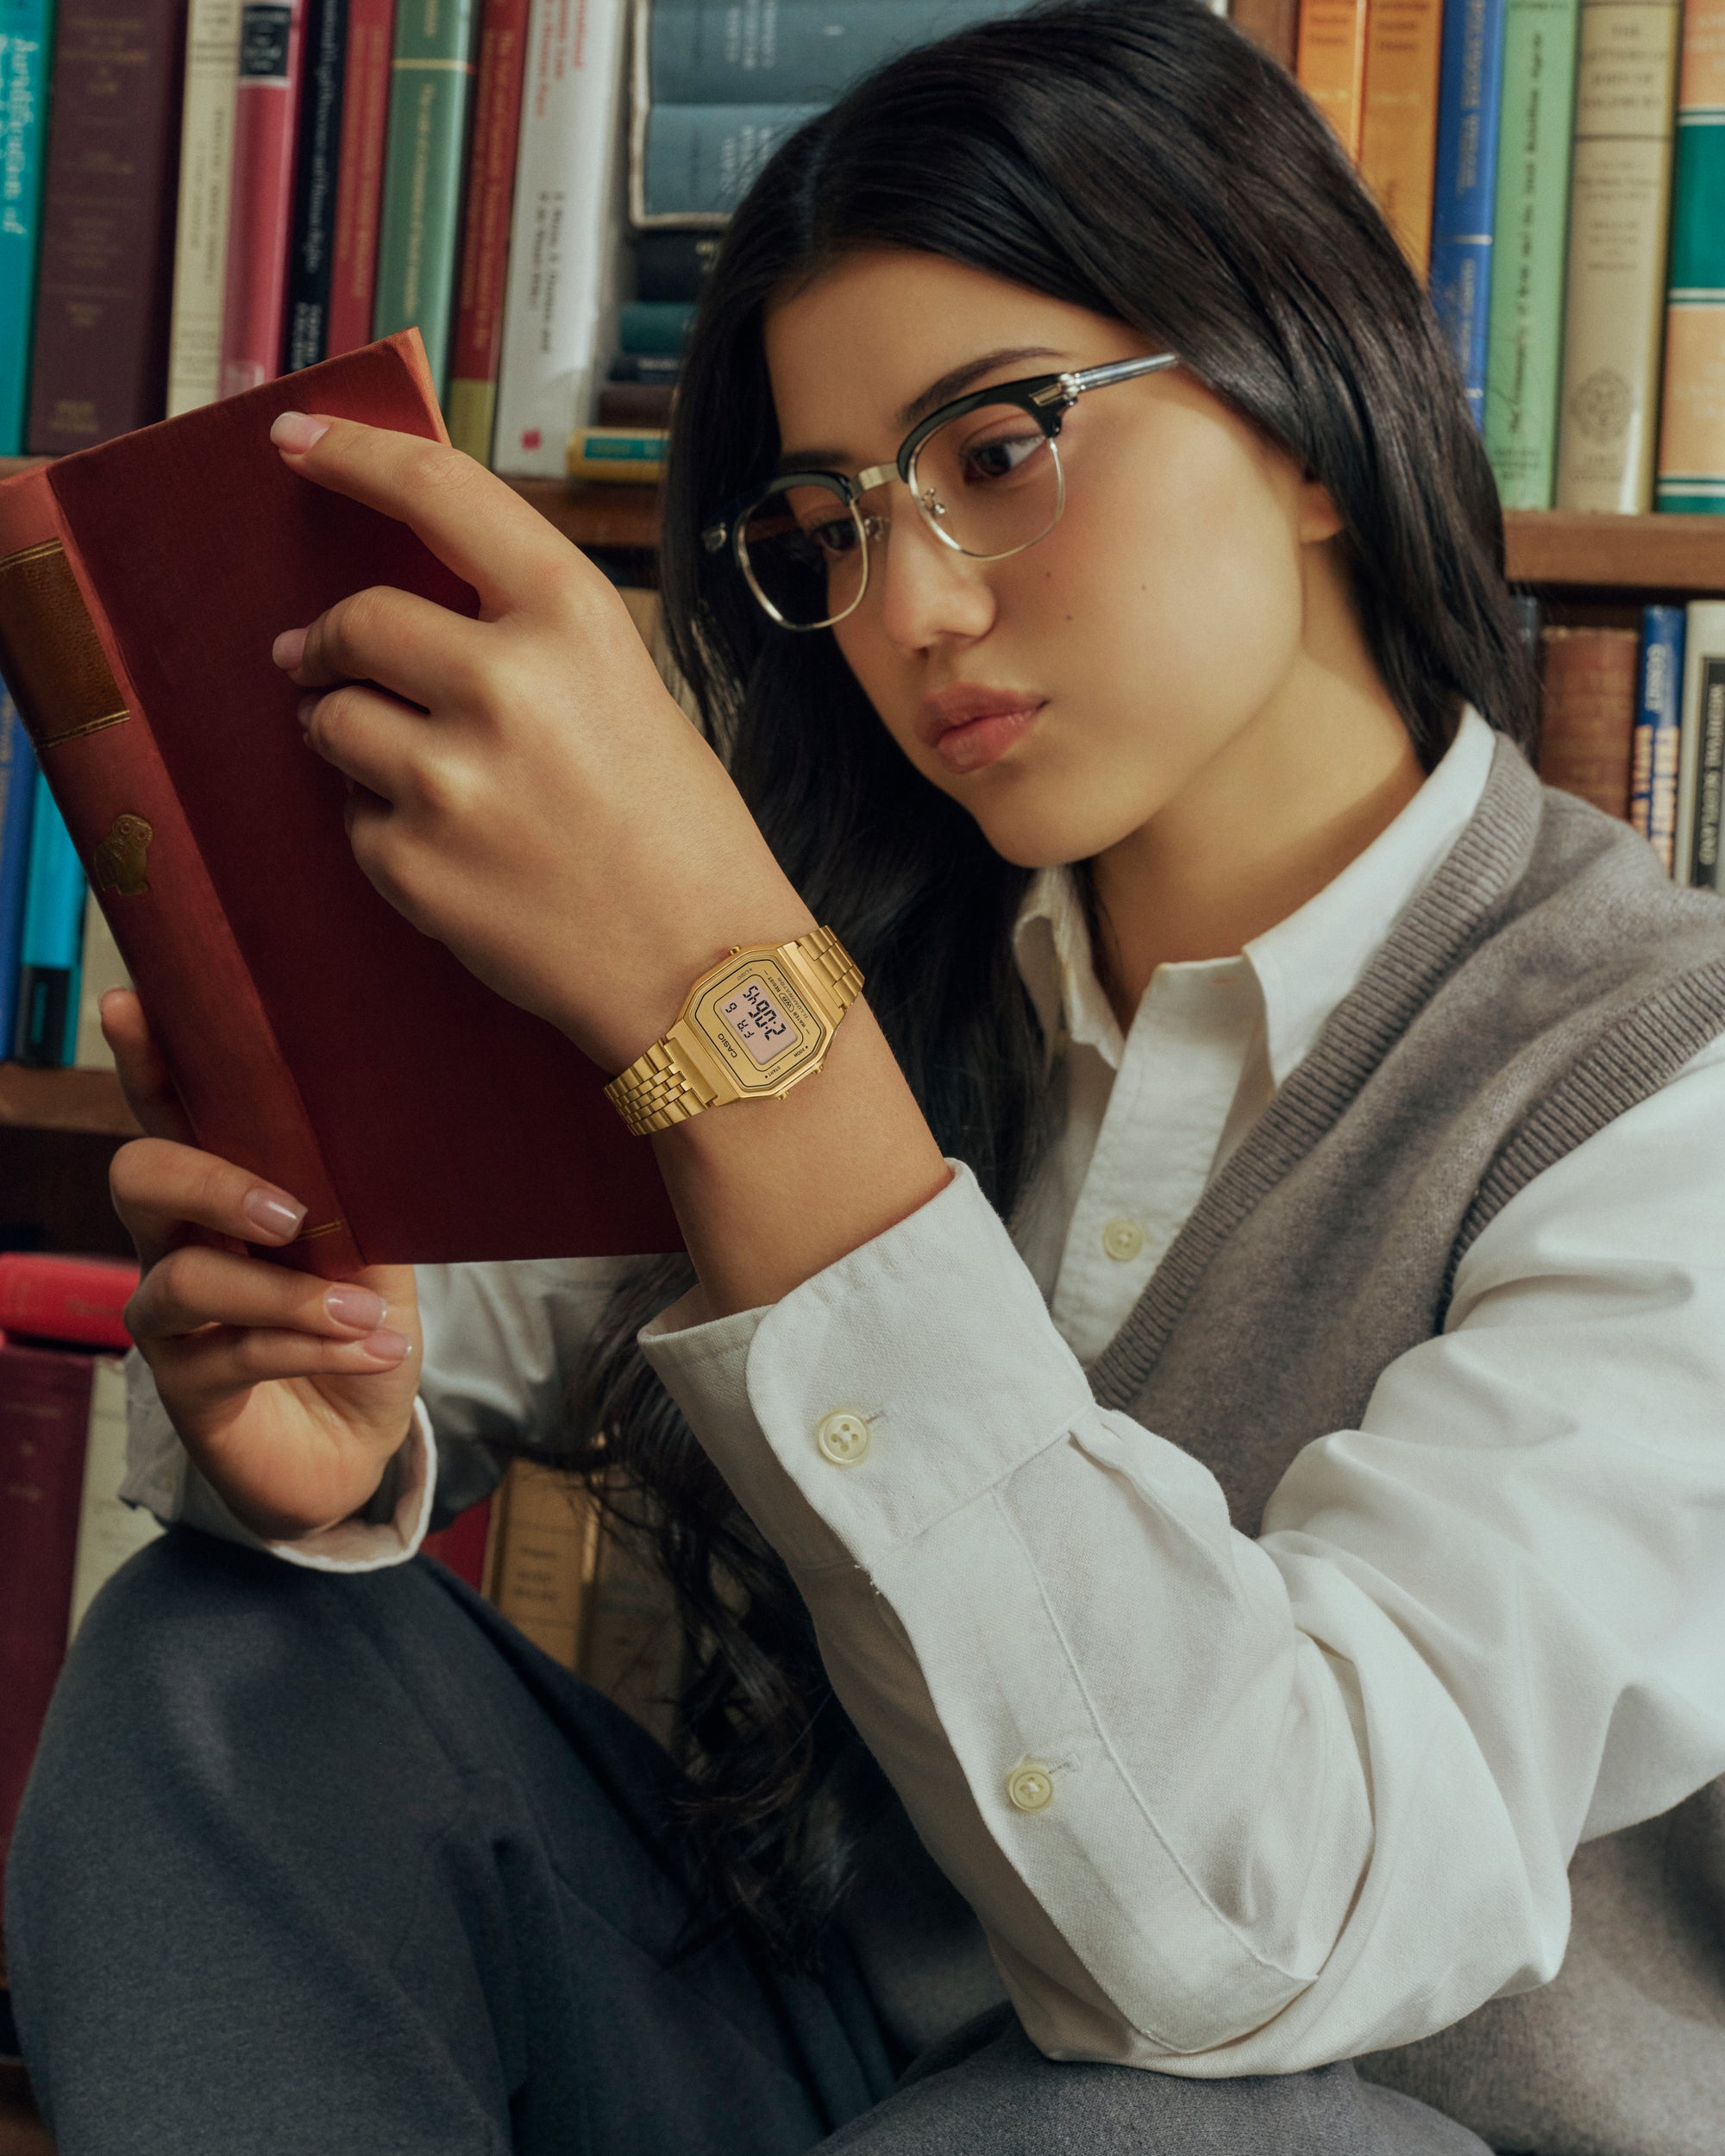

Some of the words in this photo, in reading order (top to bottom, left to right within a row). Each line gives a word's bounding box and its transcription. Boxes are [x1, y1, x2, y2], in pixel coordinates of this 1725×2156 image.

[737, 969, 750, 981] LIGHT
[768, 977, 781, 993] RESIST
[743, 985, 760, 1005] 45
[777, 977, 808, 1018] ILLUMINATOR
[781, 996, 792, 1009] WR
[725, 1002, 737, 1013] 6
[794, 1012, 806, 1027] WATER
[718, 1033, 737, 1058] CASIO
[768, 1065, 781, 1077] START
